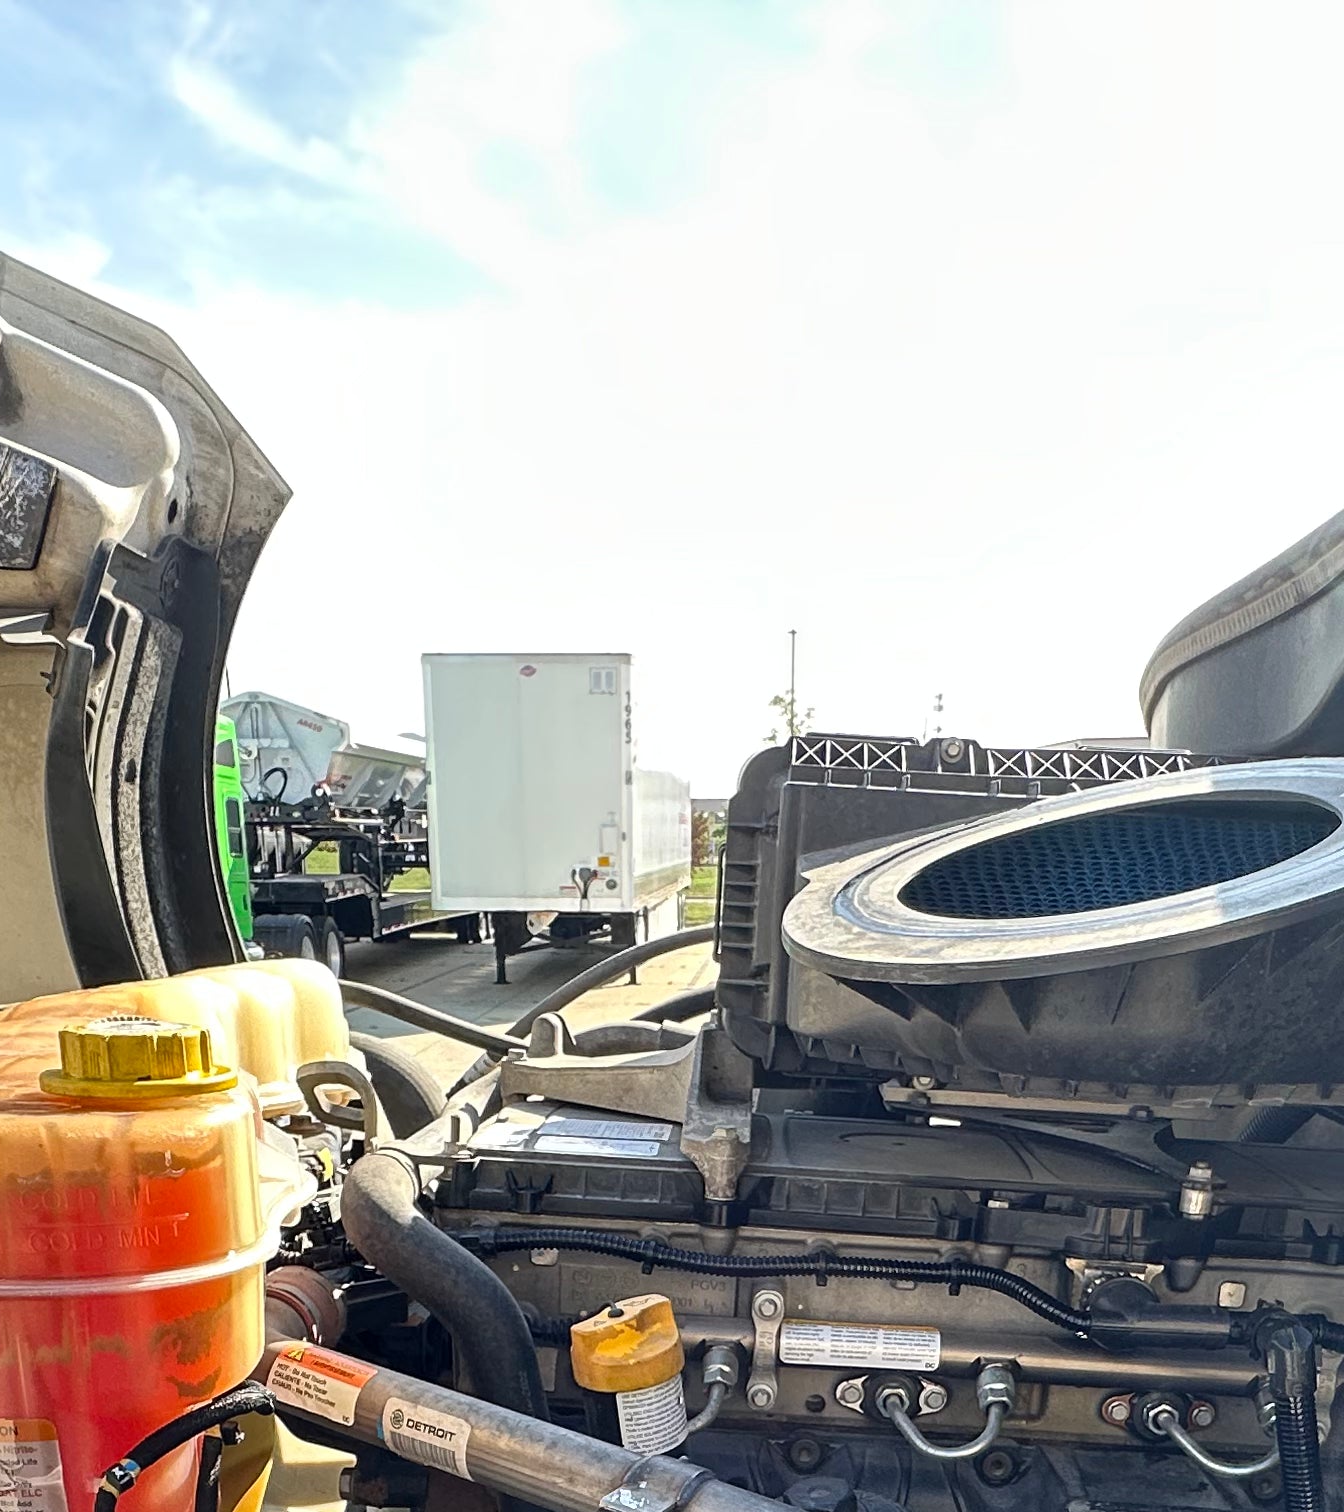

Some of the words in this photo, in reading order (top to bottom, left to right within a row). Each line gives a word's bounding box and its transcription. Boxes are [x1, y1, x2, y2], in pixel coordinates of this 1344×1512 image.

[119, 1227, 160, 1249] MIN
[406, 1418, 457, 1442] DETROIT
[21, 1489, 43, 1498] ELC
